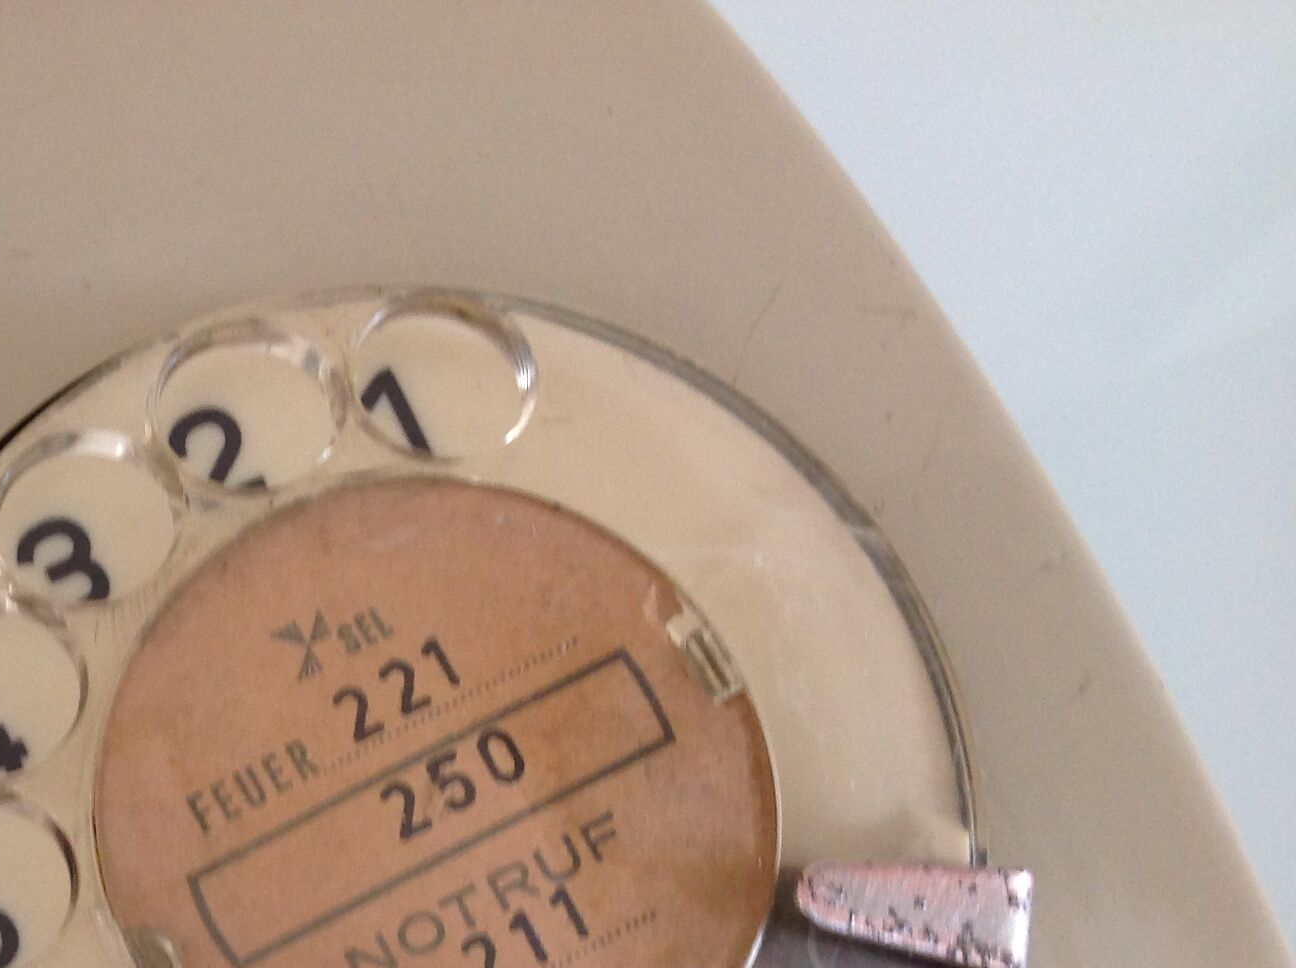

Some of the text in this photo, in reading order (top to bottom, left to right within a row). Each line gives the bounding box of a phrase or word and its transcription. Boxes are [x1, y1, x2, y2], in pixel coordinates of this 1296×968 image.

[168, 408, 268, 494] 2
[360, 366, 431, 458] 1
[16, 516, 111, 604] 3
[185, 636, 461, 833] FEUER 221
[379, 729, 526, 840] 250
